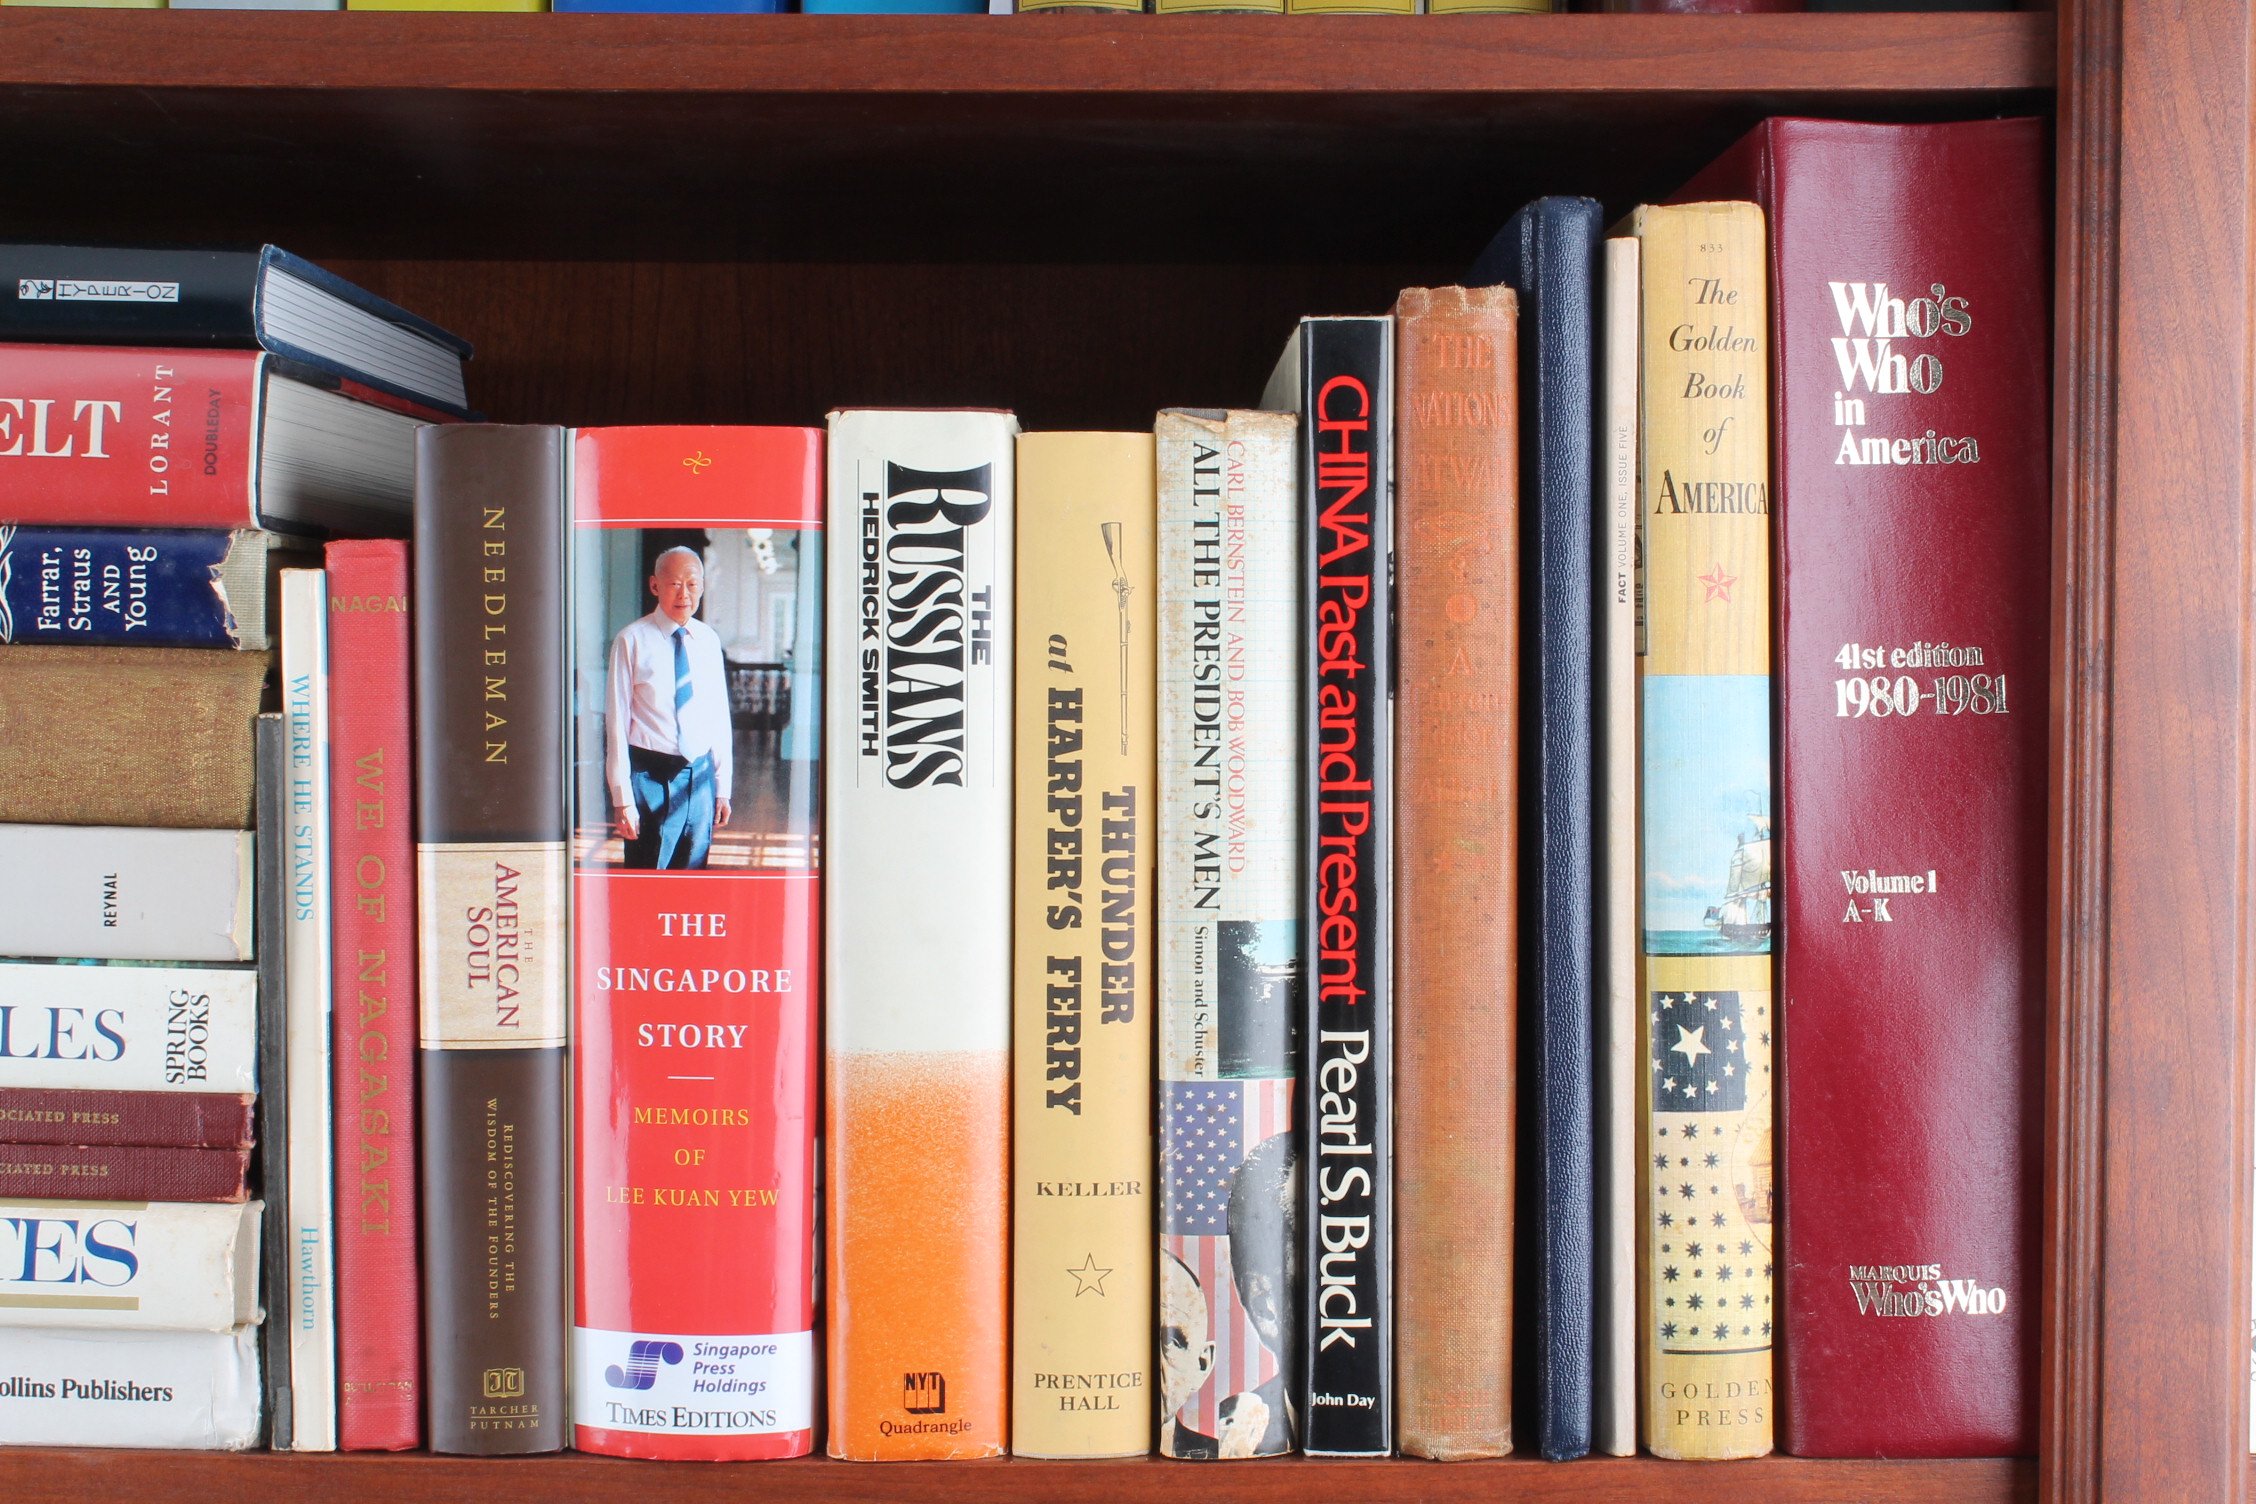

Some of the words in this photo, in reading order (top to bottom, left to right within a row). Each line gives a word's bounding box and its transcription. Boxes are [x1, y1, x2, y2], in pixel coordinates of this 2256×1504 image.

[1700, 244, 1723, 252] 833
[58, 283, 176, 300] HYPERION
[1688, 277, 1738, 305] The
[1828, 282, 1972, 338] Who's
[1434, 333, 1494, 369] THE
[1668, 324, 1758, 353] Golden
[1681, 372, 1747, 401] Book
[1830, 337, 1944, 394] Who
[151, 365, 174, 495] LORANT
[1834, 391, 1866, 426] in
[205, 389, 221, 475] DOUBLEDAY
[1618, 425, 1628, 447] FIVE
[1702, 417, 1734, 456] of
[1834, 427, 1980, 465] America
[1192, 441, 1221, 507] ALL
[1226, 440, 1245, 499] CARL
[1318, 375, 1368, 571] CHINA
[1618, 451, 1628, 485] ISSUE
[1618, 489, 1628, 519] ONE,
[1654, 469, 1768, 515] AMERICA
[862, 492, 879, 641] HEDRICK
[1193, 512, 1221, 590] THE
[1226, 504, 1245, 623] BERNSTEIN
[1618, 523, 1627, 568] VOLUME
[38, 547, 62, 630] Farrar,
[69, 548, 92, 630] Straus
[103, 563, 120, 613] AND
[126, 545, 157, 631] Young
[331, 595, 408, 612] NAGAI
[1618, 571, 1626, 603] FACT
[483, 507, 507, 764] NEEDLEMAN
[886, 461, 992, 790] RUSSIANS
[971, 584, 991, 666] THE
[1319, 575, 1371, 678] Past
[1047, 634, 1074, 673] at
[1226, 634, 1245, 682] AND
[1834, 643, 1886, 670] 41st
[1890, 641, 1984, 668] edition
[862, 648, 879, 756] SMITH
[1193, 600, 1222, 821] PRESIDENT'S
[1227, 690, 1245, 730] BOB
[1835, 673, 2009, 718] 1980-1981
[291, 674, 311, 768] WHERE
[1318, 685, 1372, 791] and
[293, 780, 312, 814] HE
[355, 748, 384, 830] WE
[1046, 687, 1083, 930] HARPER'S
[1227, 732, 1246, 874] WOODWARD
[294, 825, 314, 922] STANDS
[356, 855, 385, 923] OF
[1194, 831, 1221, 912] MEN
[104, 873, 117, 927] REYNAL
[1100, 785, 1136, 1025] THUNDER
[1318, 799, 1373, 1004] Present
[467, 906, 492, 989] SOUL
[494, 862, 521, 1029] AMERICAN
[524, 928, 534, 963] THE
[658, 913, 728, 938] THE
[1195, 926, 1209, 974] Simon
[597, 967, 793, 993] SINGAPORE
[1195, 979, 1208, 1006] and
[0, 1006, 126, 1061] LES
[166, 987, 189, 1085] SPRING
[188, 993, 210, 1082] BOOKS
[638, 1023, 749, 1049] STORY
[1046, 955, 1082, 1116] FERRY
[1195, 1009, 1209, 1077] Schuster
[357, 949, 390, 1236] NAGASAKI
[1319, 1030, 1373, 1156] Pearl
[71, 1111, 120, 1125] PRESS
[487, 1098, 498, 1162] WISDOM
[634, 1108, 749, 1126] MEMOIRS
[61, 1164, 109, 1177] PRESS
[487, 1170, 498, 1189] OF
[674, 1148, 706, 1166] OF
[504, 1124, 515, 1254] REDISCOVERING
[606, 1186, 645, 1205] LEE
[654, 1188, 719, 1207] KUAN
[729, 1188, 780, 1207] YEW
[1036, 1180, 1143, 1198] KELLER
[1319, 1166, 1370, 1206] S.
[488, 1198, 498, 1227] THE
[300, 1227, 319, 1331] Hawthorn
[489, 1236, 499, 1319] FOUNDERS
[505, 1262, 515, 1292] THE
[1320, 1214, 1374, 1353] Buck
[1850, 1263, 1941, 1283] MARQUIS
[693, 1342, 777, 1361] Singapore
[693, 1362, 735, 1375] Press
[0, 1377, 56, 1398] ollins
[61, 1379, 173, 1402] Publishers
[693, 1378, 767, 1394] Holdings
[904, 1373, 940, 1391] NYT
[1033, 1371, 1143, 1390] PRENTICE
[1312, 1392, 1343, 1408] John
[1346, 1393, 1376, 1410] Day
[470, 1404, 538, 1415] TARCHER
[470, 1420, 539, 1430] PUTNAM
[606, 1401, 666, 1428] TIMES
[672, 1405, 777, 1428] EDITIONS
[1059, 1395, 1120, 1412] HALL
[1676, 1407, 1763, 1426] PRESS
[879, 1419, 972, 1438] Quadrangle
